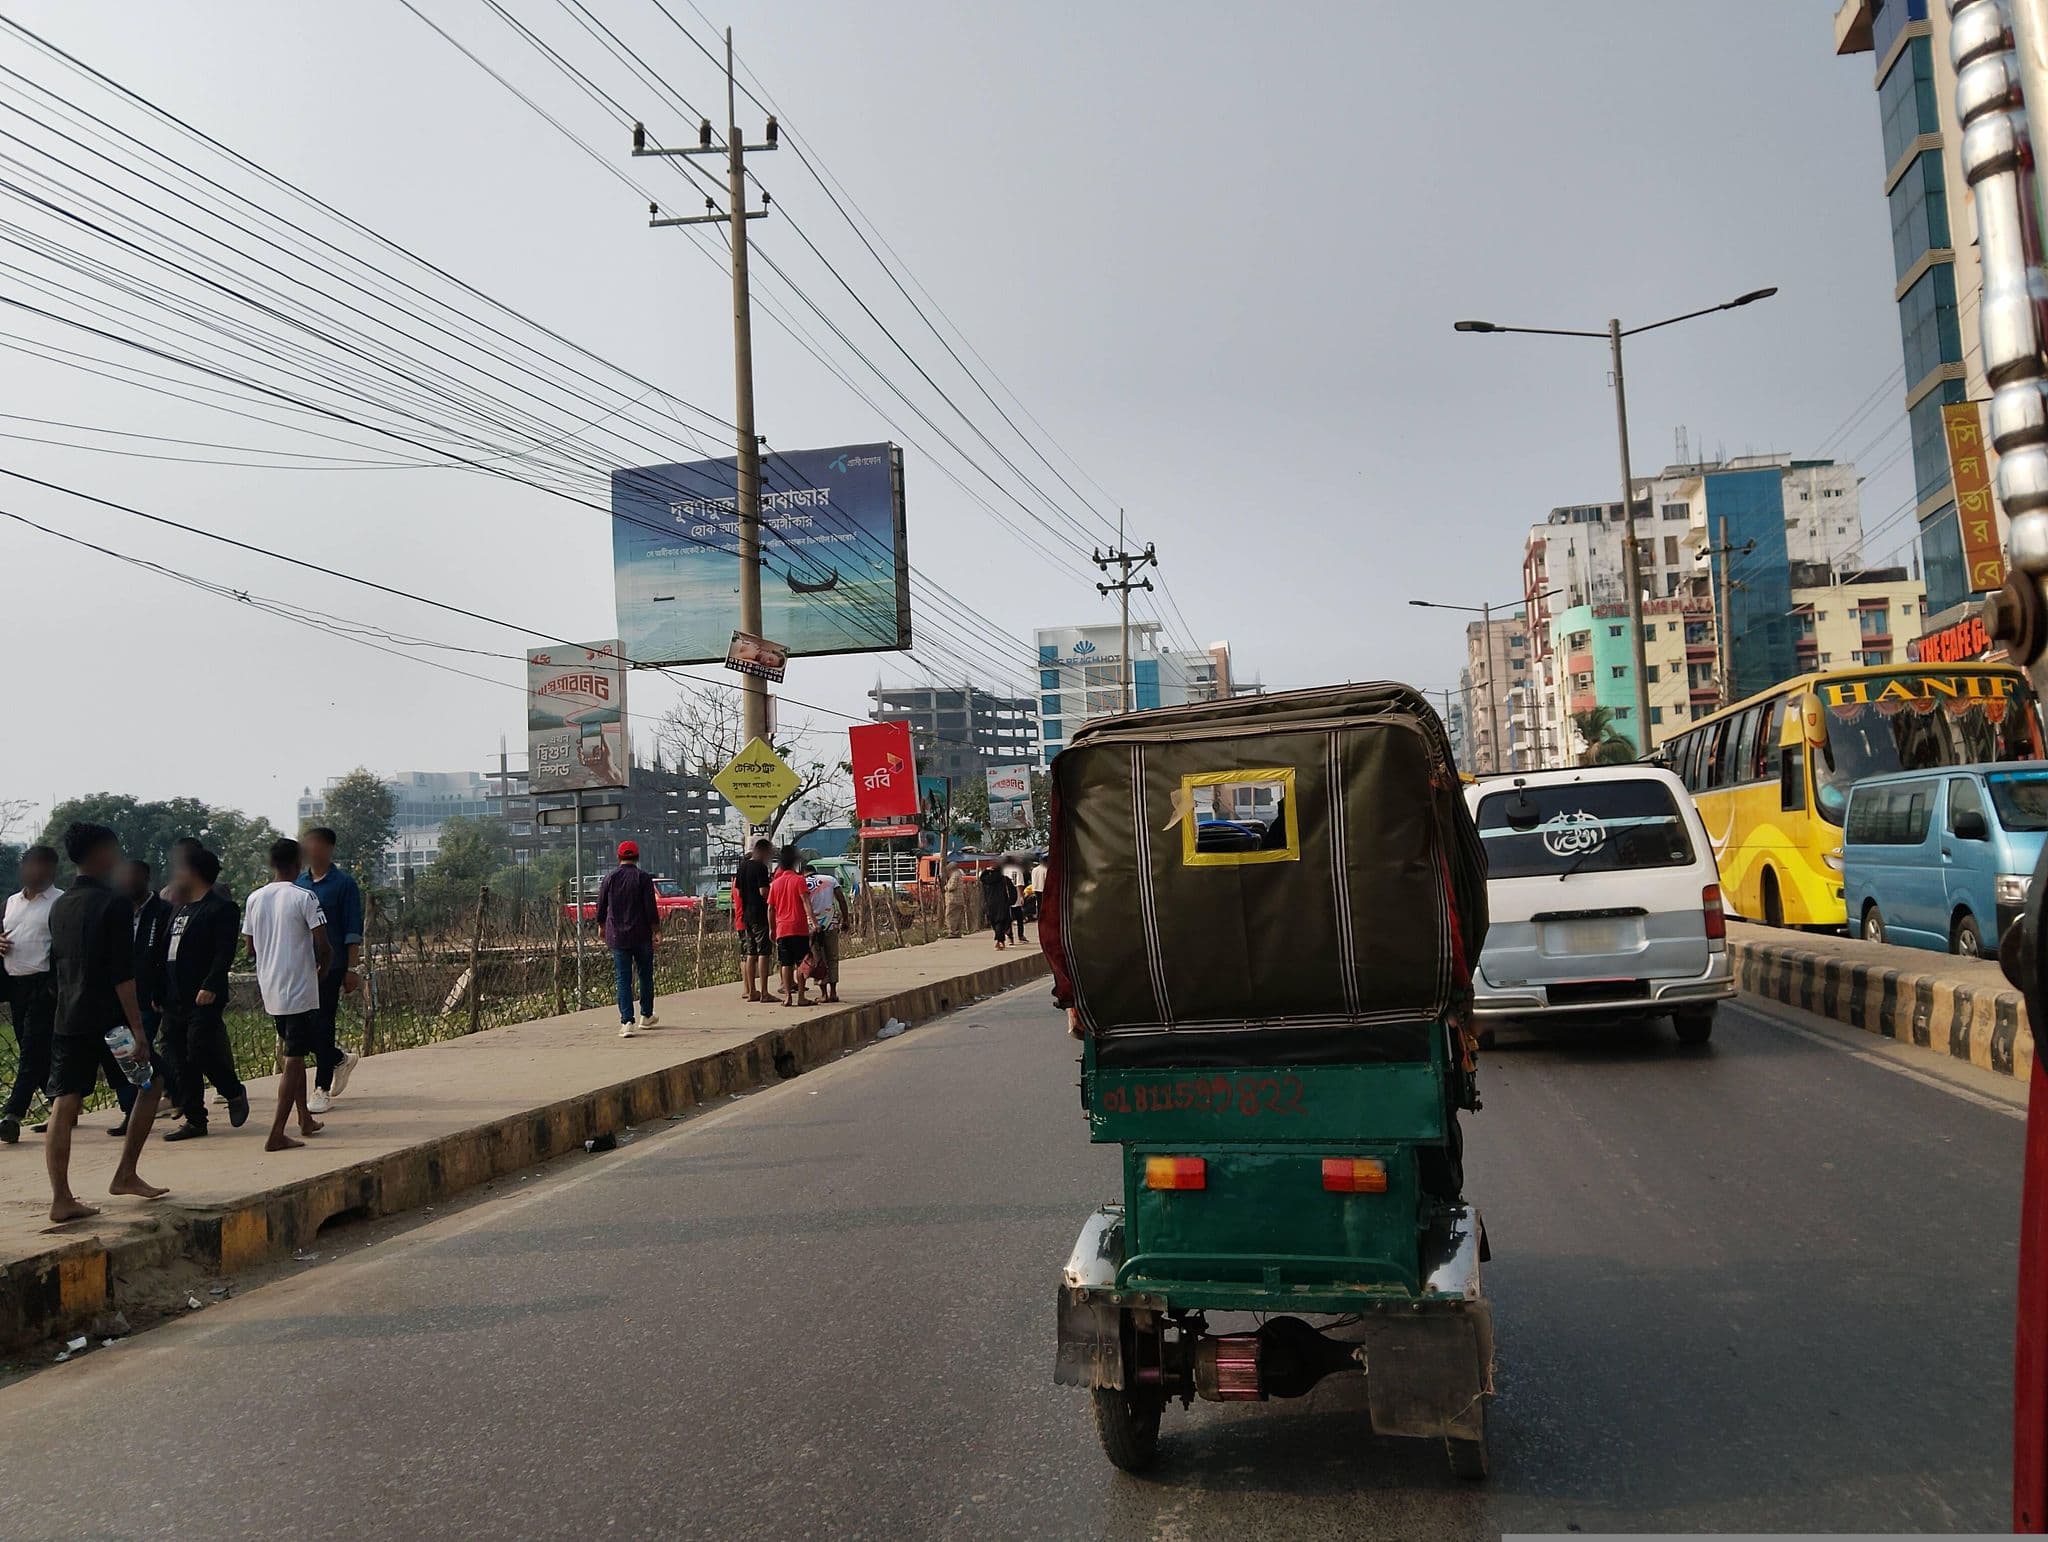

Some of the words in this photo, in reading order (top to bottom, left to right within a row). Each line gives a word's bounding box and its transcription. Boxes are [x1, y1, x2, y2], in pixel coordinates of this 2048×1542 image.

[1919, 633, 1941, 662] THE
[1941, 620, 1972, 662] CAFE
[1823, 676, 2019, 707] HANIF
[863, 767, 891, 791] রবি
